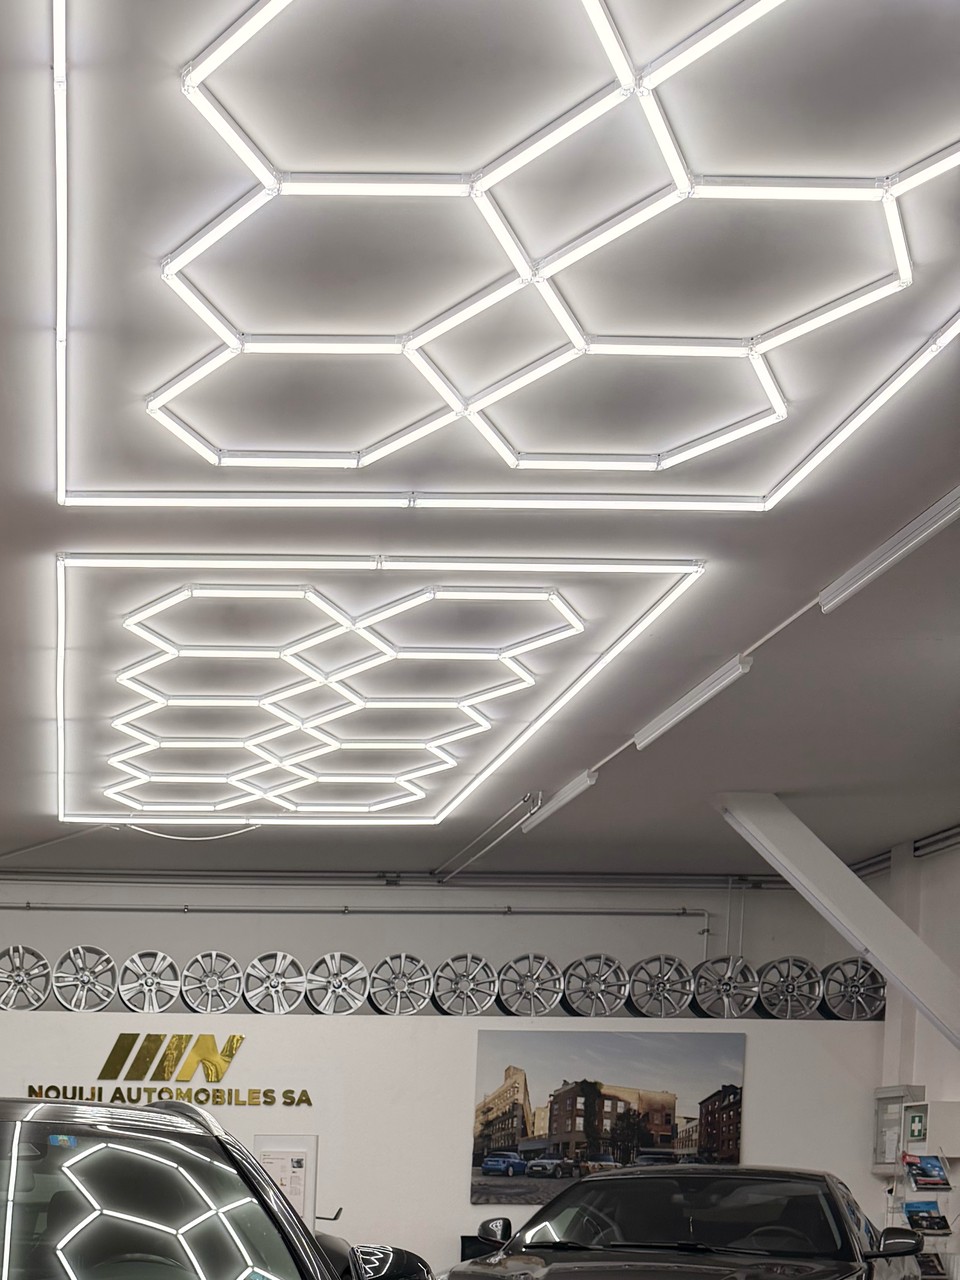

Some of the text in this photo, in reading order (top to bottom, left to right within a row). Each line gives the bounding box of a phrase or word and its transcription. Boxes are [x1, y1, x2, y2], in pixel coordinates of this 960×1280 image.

[28, 1085, 313, 1107] NOUIJI AUTOMOBILES SA
